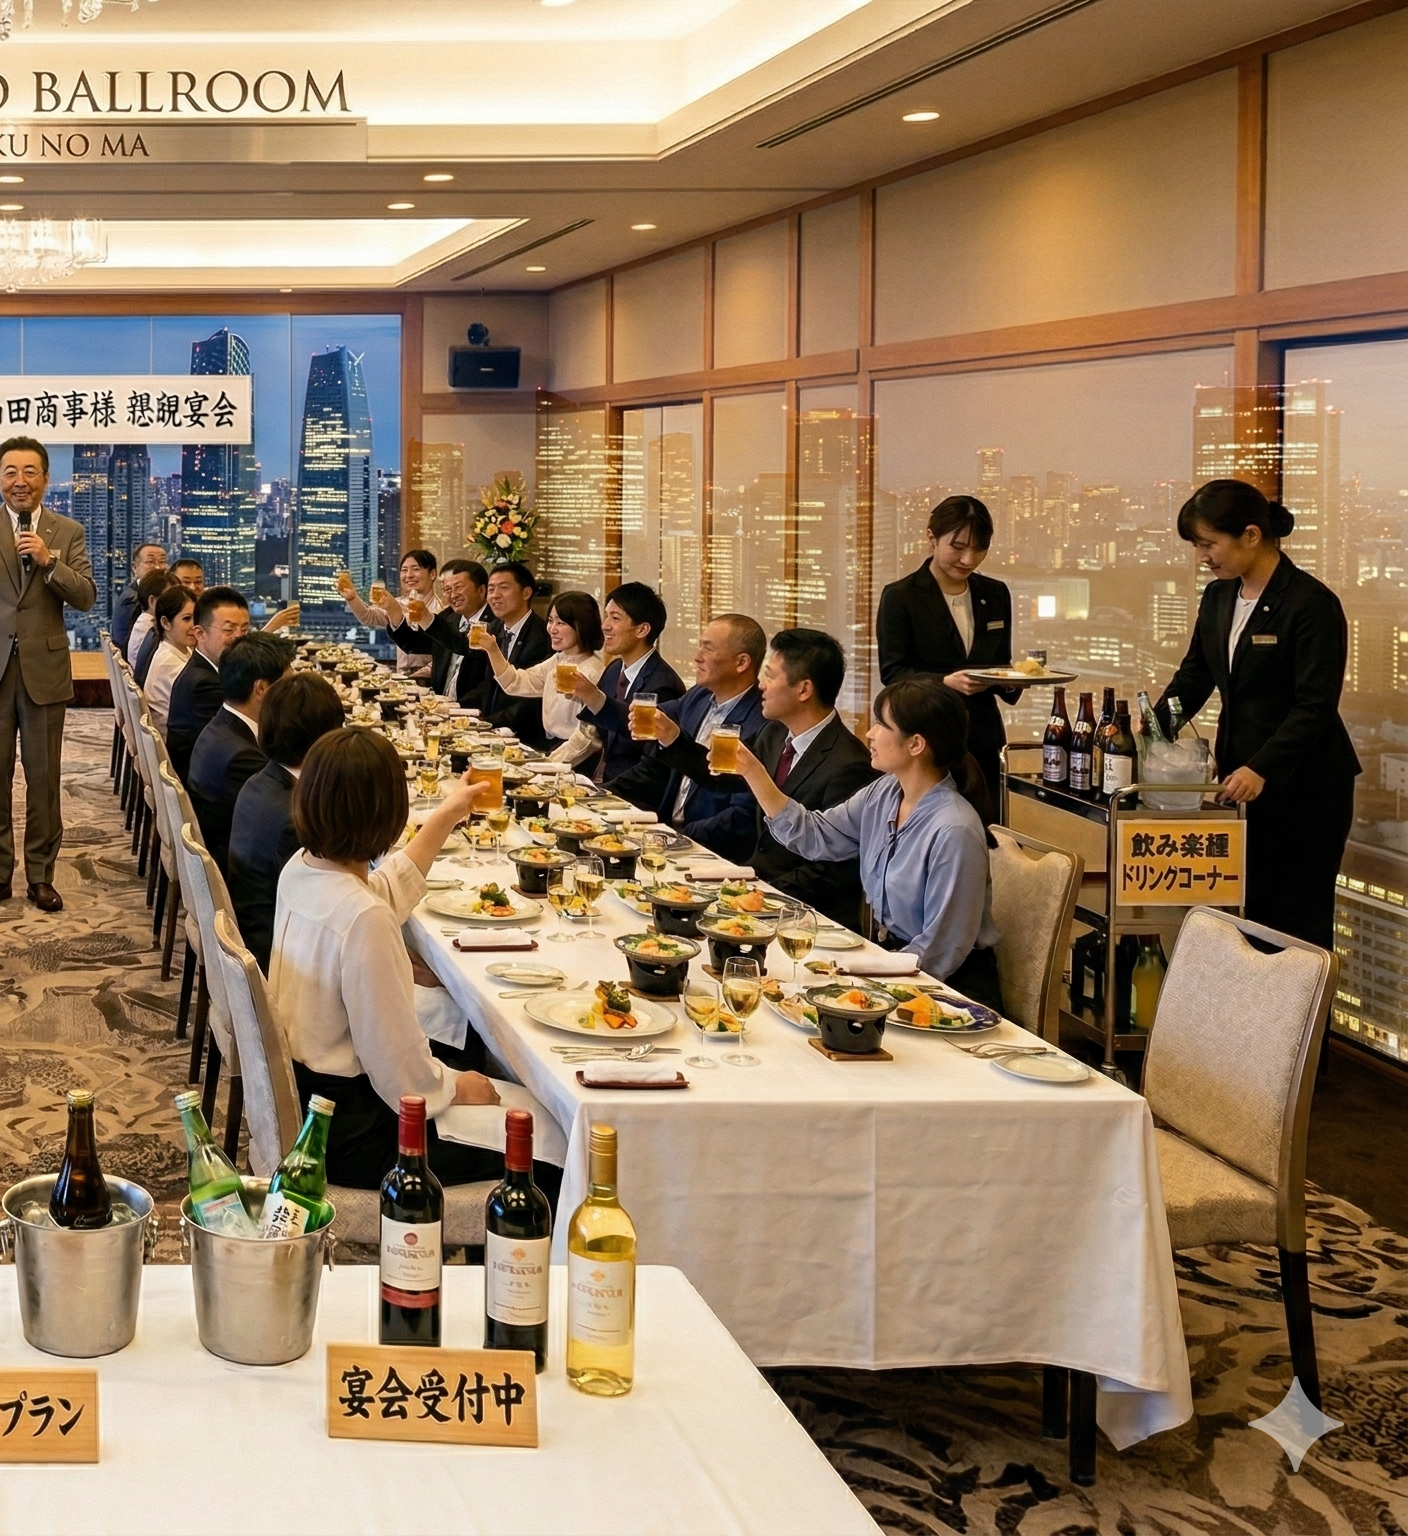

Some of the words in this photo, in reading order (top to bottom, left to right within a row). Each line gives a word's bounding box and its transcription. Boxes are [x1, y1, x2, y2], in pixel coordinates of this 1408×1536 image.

[33, 70, 353, 113] BALLROOM
[40, 133, 90, 157] NO
[100, 133, 150, 157] MA
[338, 1364, 526, 1426] 宴会受付中
